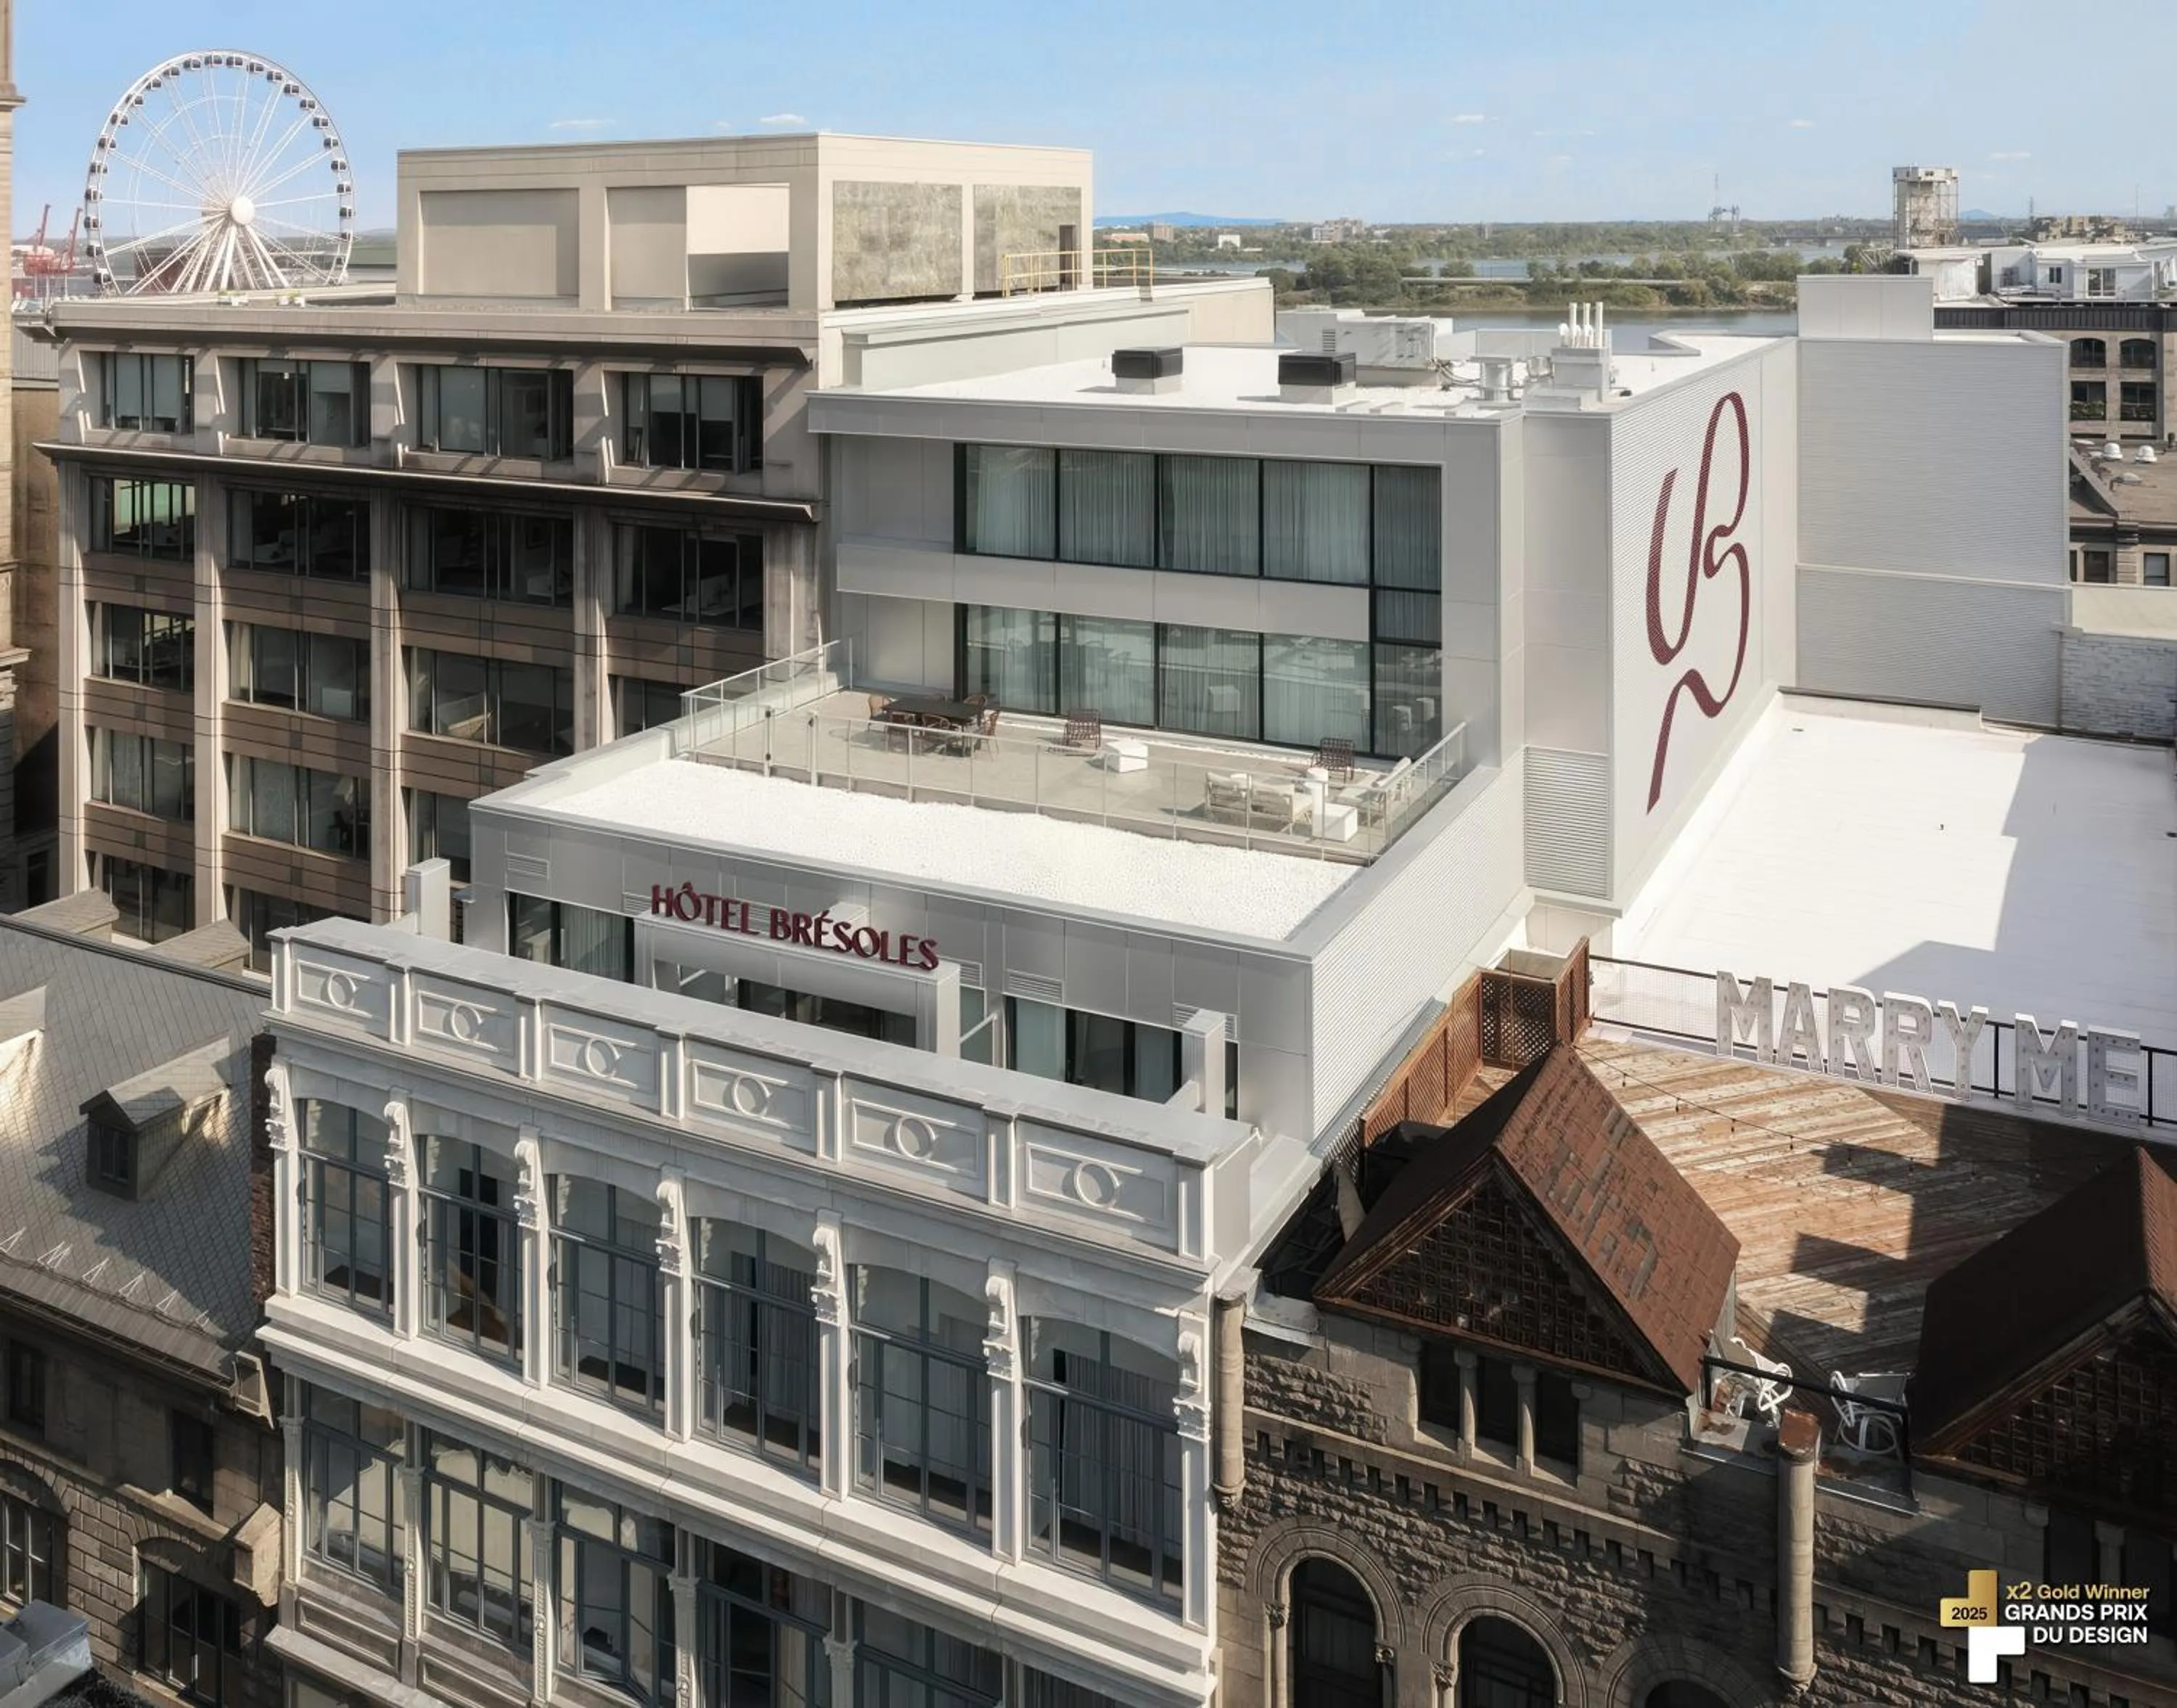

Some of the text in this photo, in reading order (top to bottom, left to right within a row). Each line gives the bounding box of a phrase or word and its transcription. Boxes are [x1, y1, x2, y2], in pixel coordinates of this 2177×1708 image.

[652, 882, 940, 971] HÔTEL BRÉSOLES
[1716, 970, 2141, 1126] MARRY ME
